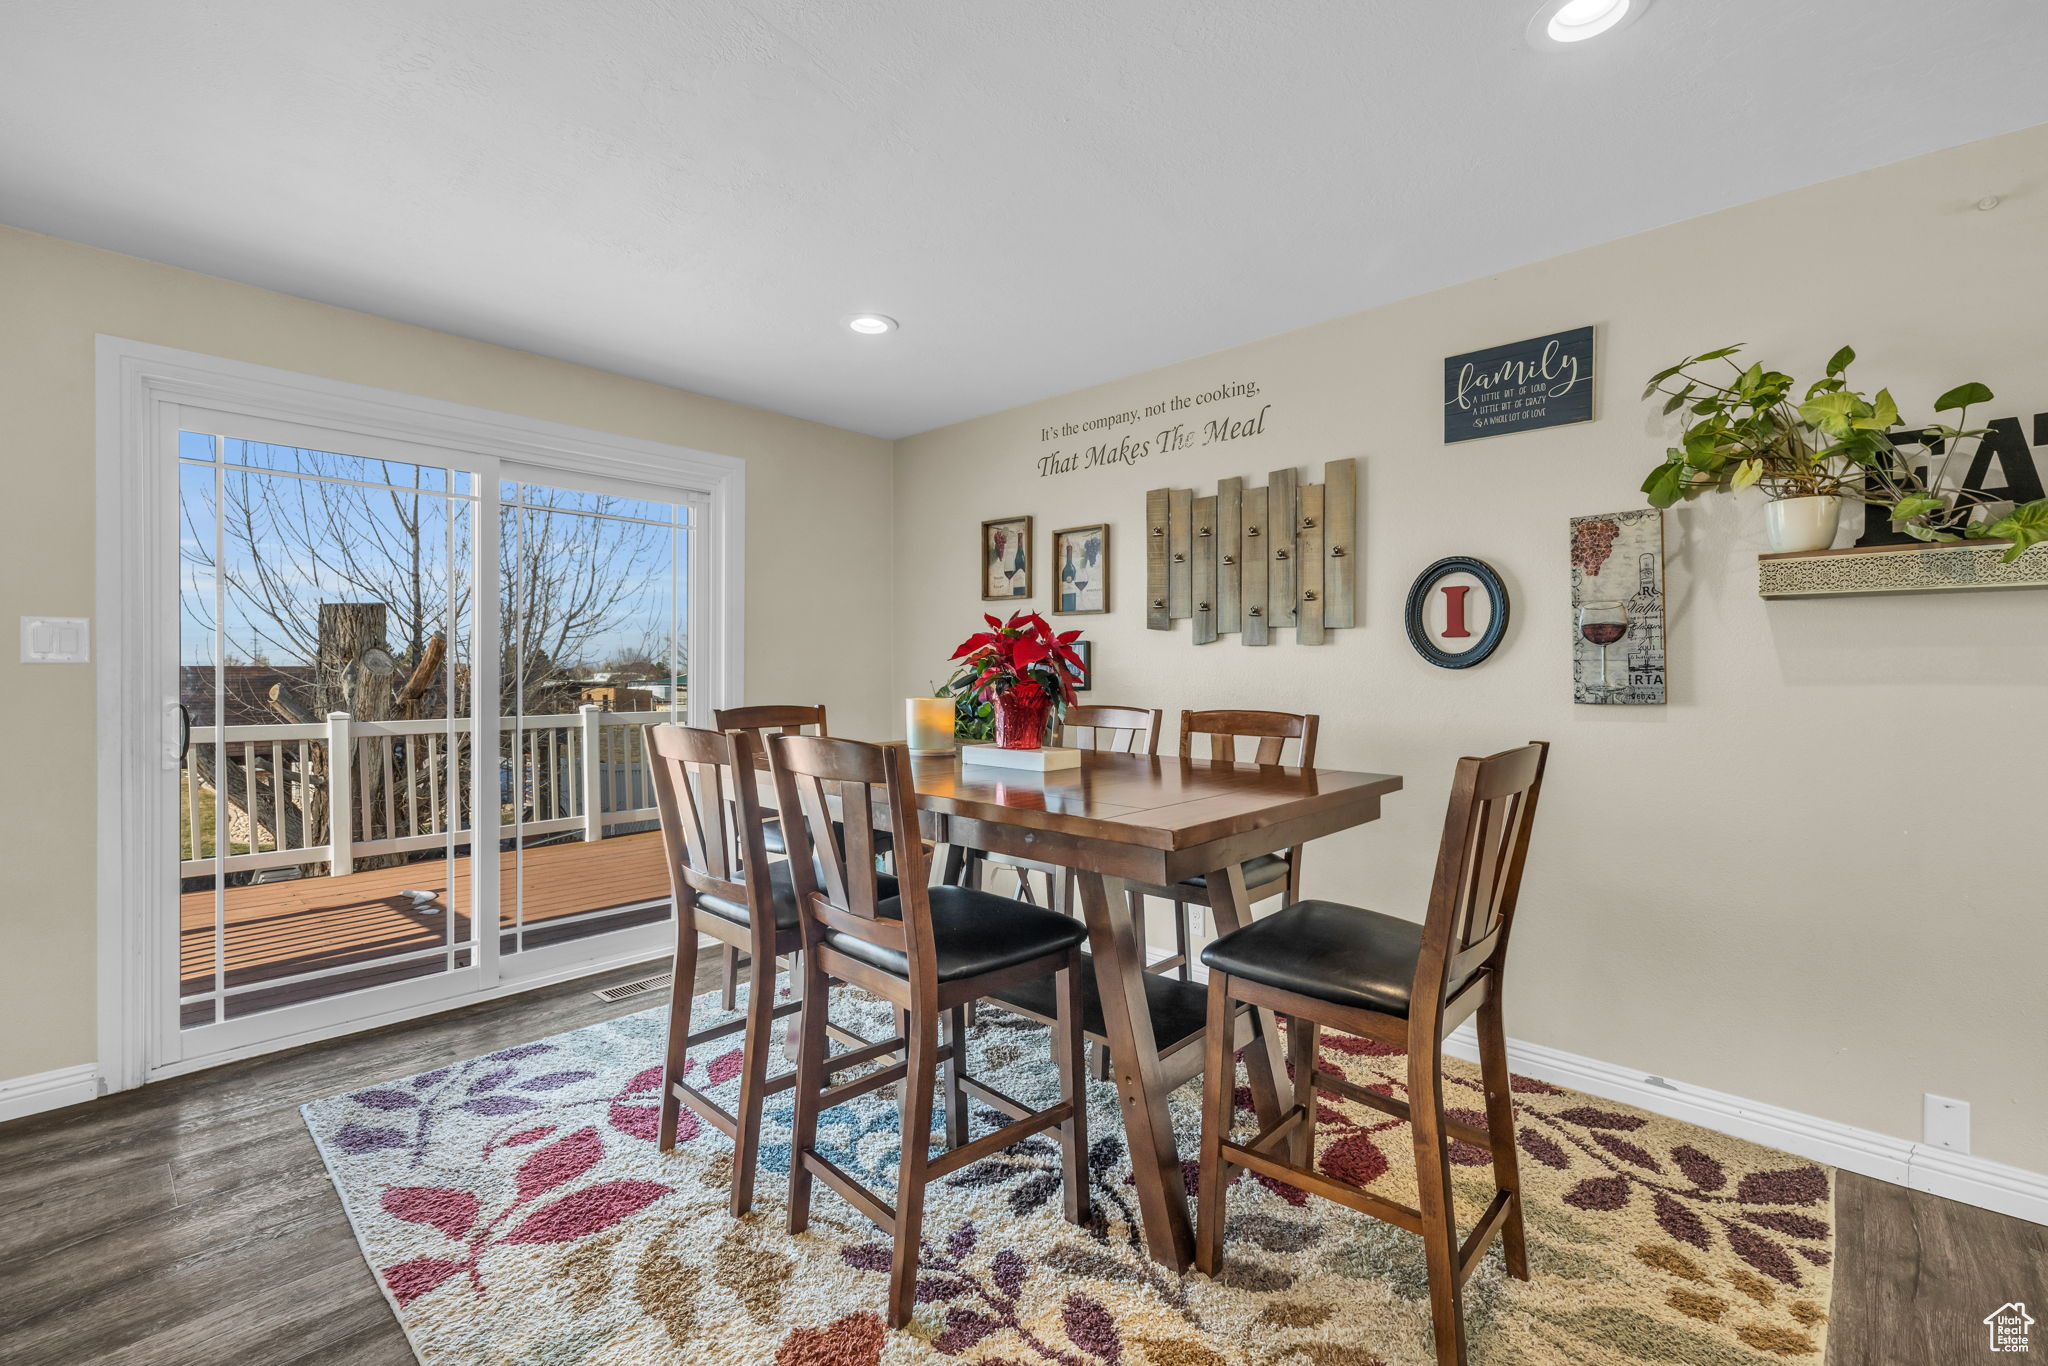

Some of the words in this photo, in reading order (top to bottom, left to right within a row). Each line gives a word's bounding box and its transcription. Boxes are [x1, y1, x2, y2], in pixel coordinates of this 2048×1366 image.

[1446, 340, 1592, 410] family
[1473, 395, 1478, 404] A
[1481, 391, 1500, 402] LITTLE
[1504, 388, 1515, 398] BIT
[1519, 385, 1527, 395] OF
[1531, 382, 1547, 393] LOUD
[1041, 426, 1059, 441] It's
[1062, 423, 1079, 437] the
[1082, 409, 1140, 431] company,
[1145, 401, 1165, 417] not
[1170, 395, 1191, 411] the
[1196, 381, 1260, 405] cooking,
[1473, 407, 1478, 416] A
[1480, 403, 1500, 415] LITTLE
[1501, 401, 1512, 411] BIT
[1514, 399, 1523, 409] OF
[1525, 395, 1547, 407] CRAZY
[1483, 417, 1489, 426] A
[1489, 413, 1508, 425] WHOLE
[1508, 411, 1521, 422] LOT
[1521, 409, 1530, 419] OF
[1531, 407, 1546, 418] LOVE
[1038, 450, 1079, 477] That
[1084, 435, 1150, 469] Makes
[1202, 404, 1271, 446] Meal
[1441, 586, 1471, 637] I
